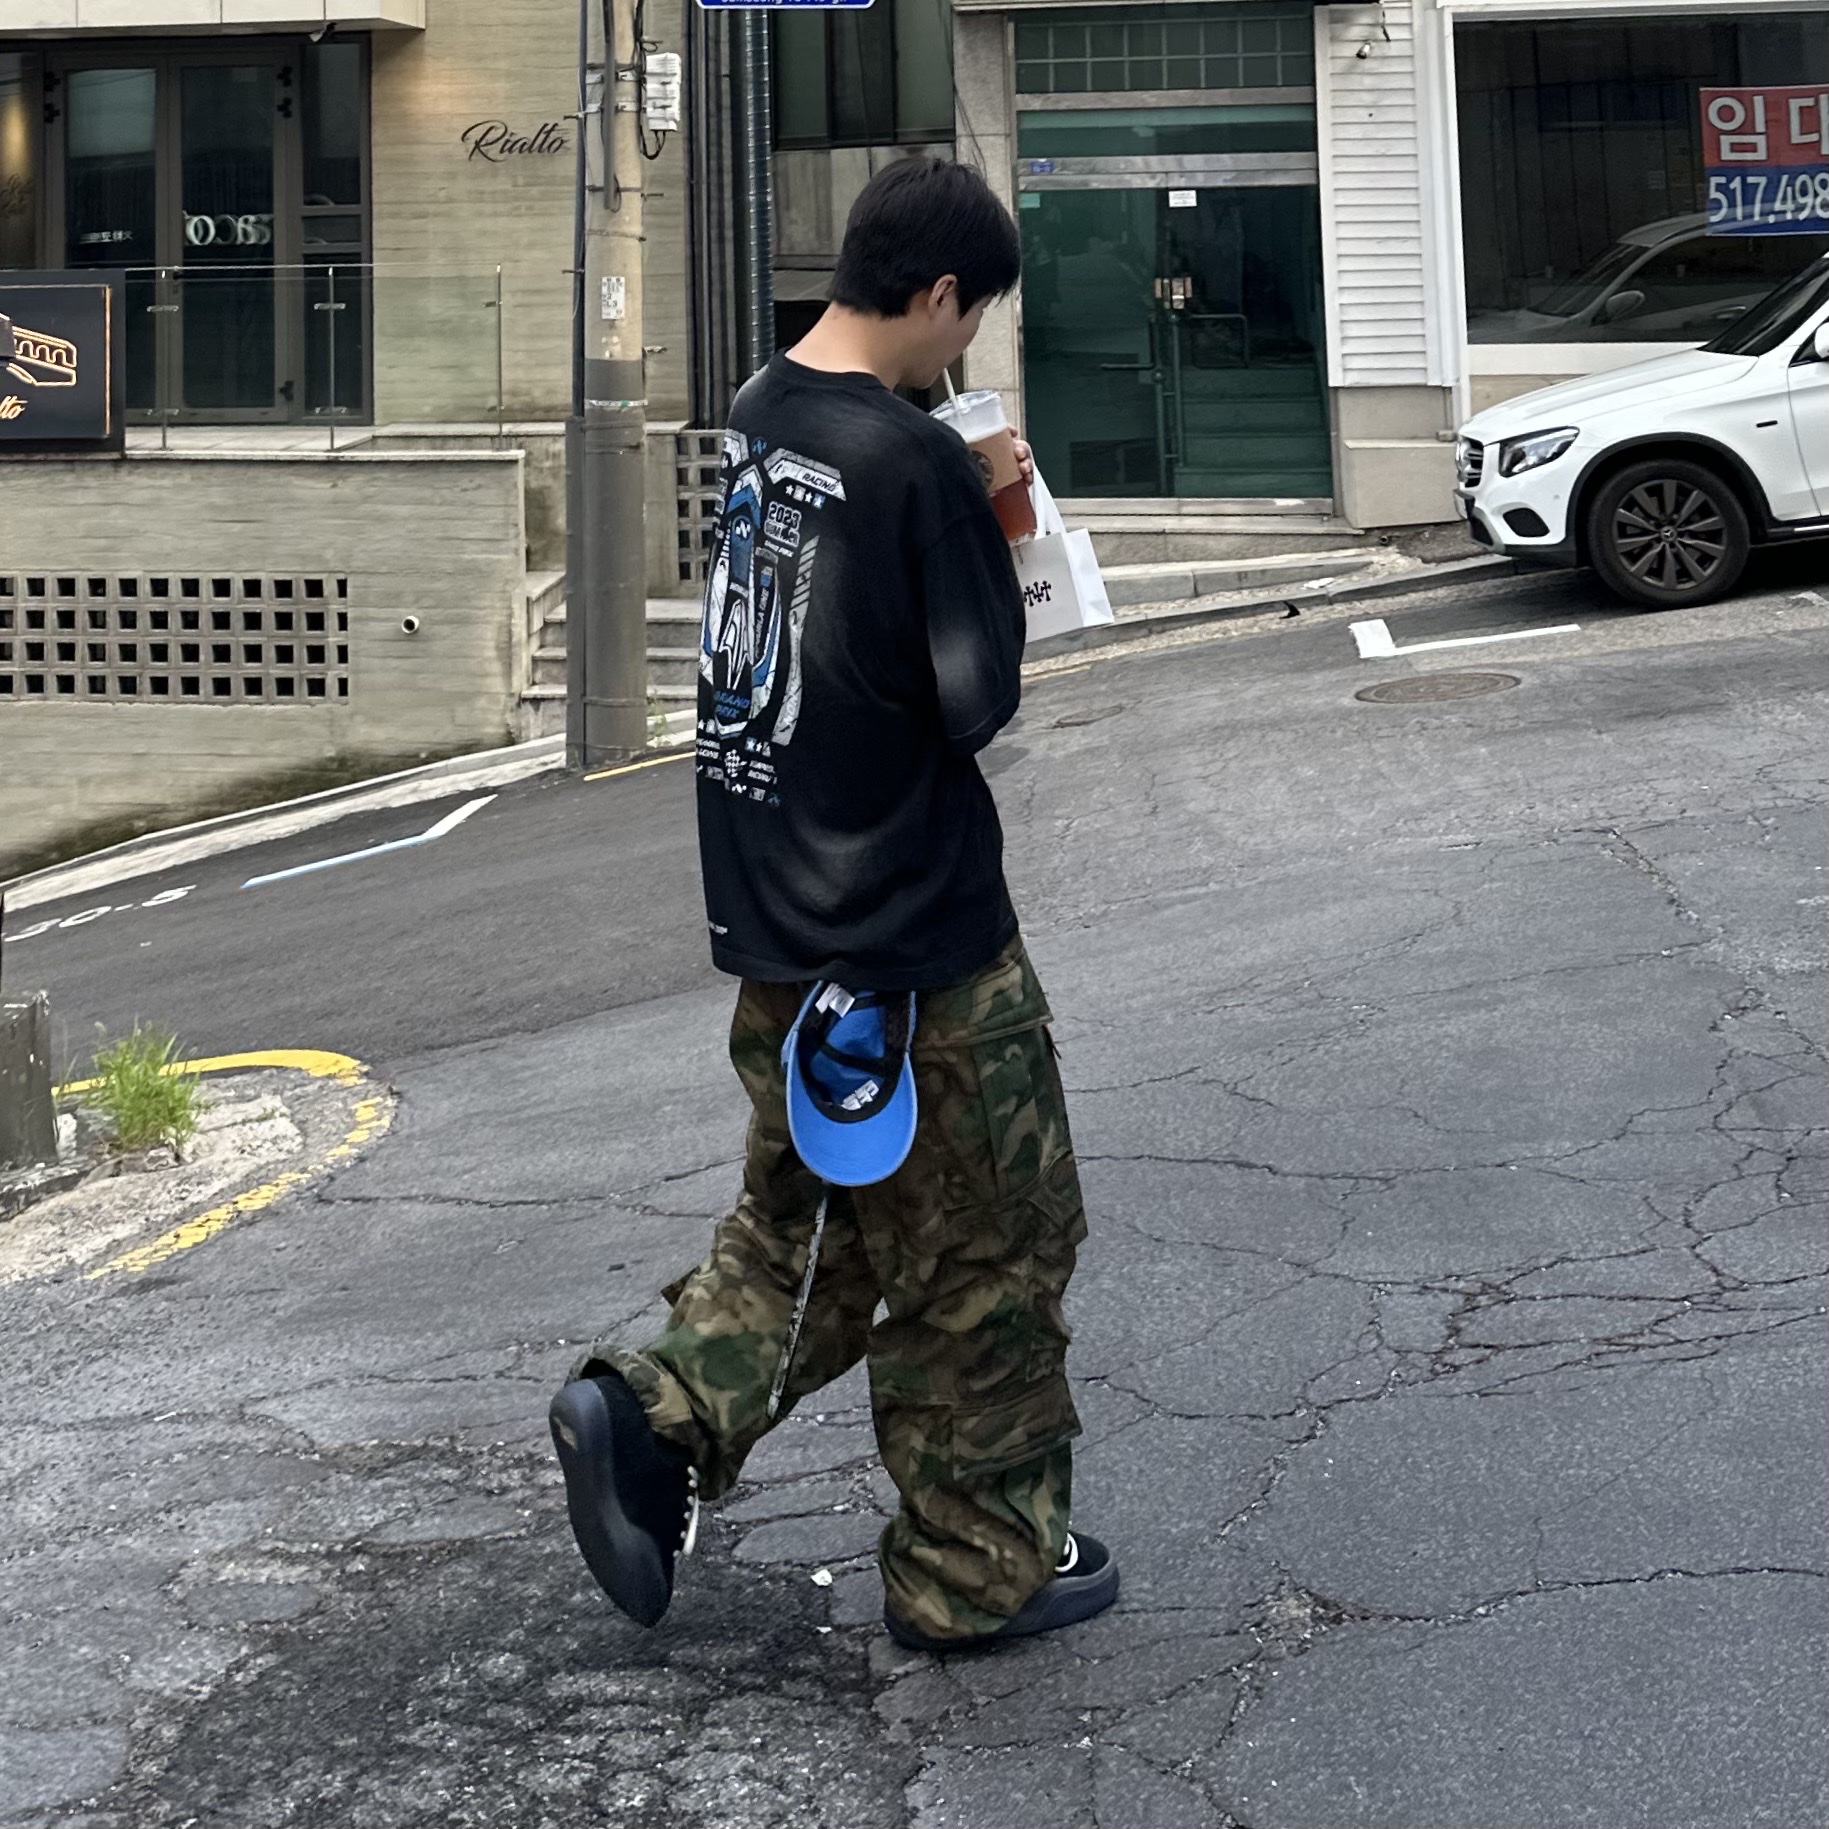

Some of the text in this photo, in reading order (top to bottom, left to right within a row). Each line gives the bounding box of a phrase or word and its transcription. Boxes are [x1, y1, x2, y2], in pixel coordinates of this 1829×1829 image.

[461, 120, 568, 162] Rialto
[1709, 172, 1829, 223] 517.498
[802, 473, 836, 492] RACING
[769, 503, 800, 530] 2023
